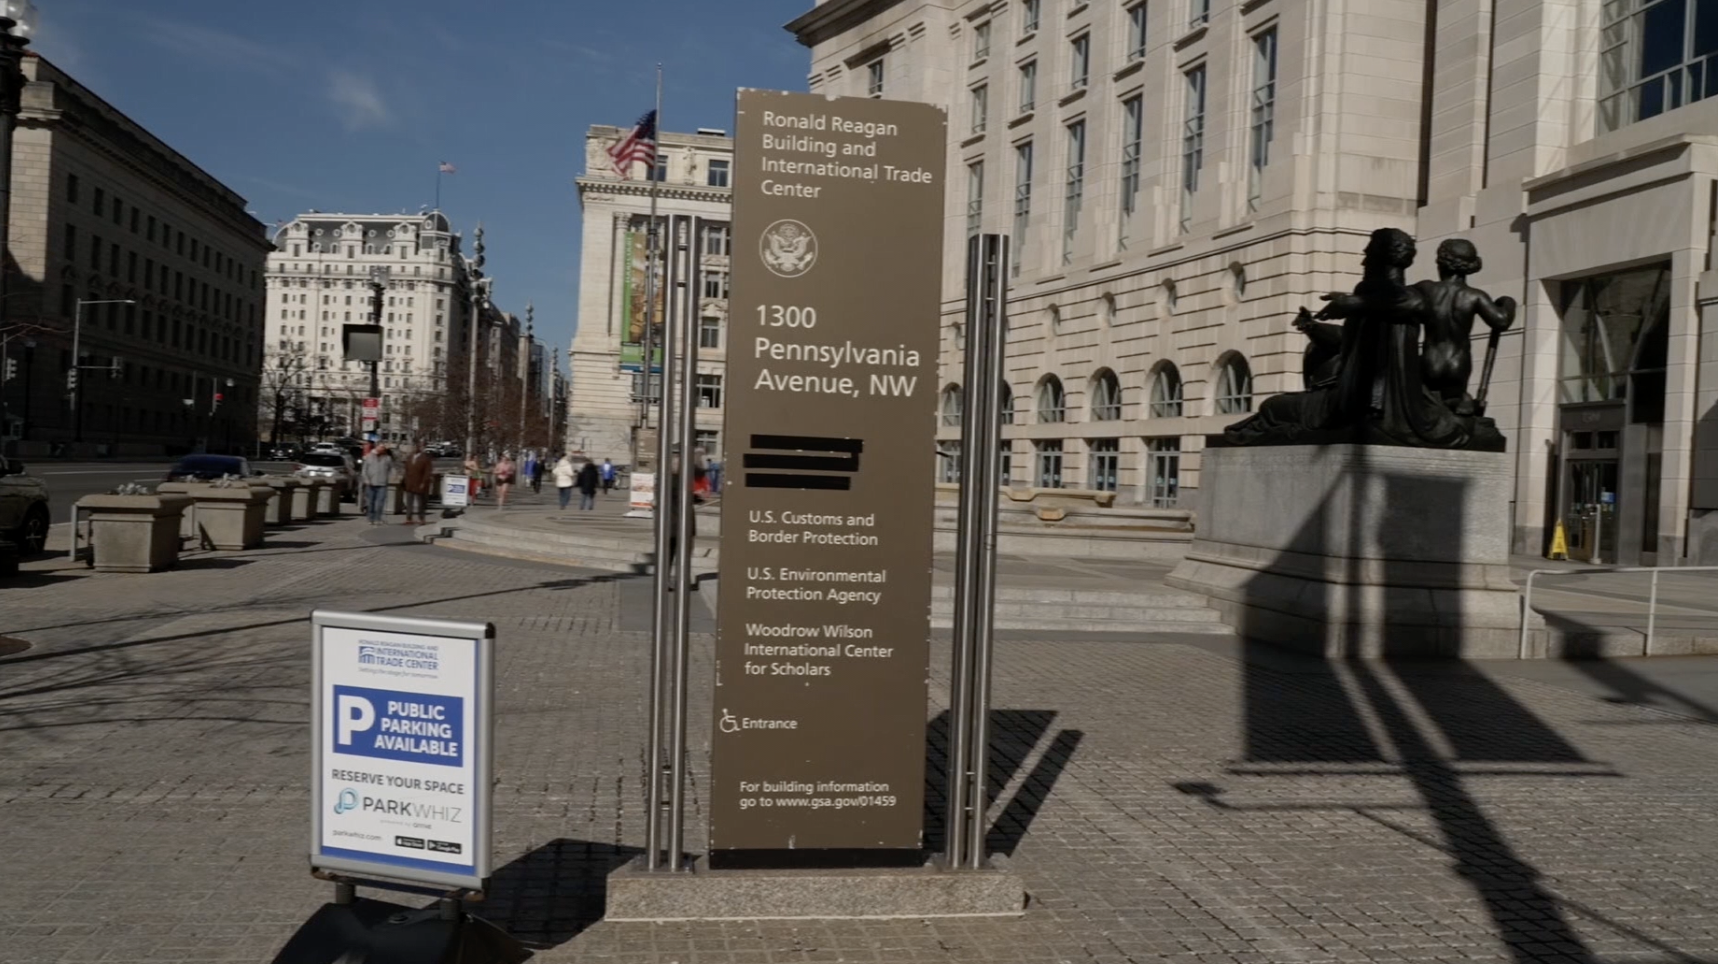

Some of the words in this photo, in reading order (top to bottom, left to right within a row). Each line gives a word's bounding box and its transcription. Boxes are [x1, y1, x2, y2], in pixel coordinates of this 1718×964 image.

[764, 111, 826, 130] Ronald
[832, 117, 898, 138] Reagan
[762, 134, 836, 157] Building
[842, 142, 876, 157] and
[761, 157, 878, 180] International
[884, 166, 932, 184] Trade
[761, 180, 821, 198] Center
[757, 305, 816, 329] 1300
[755, 337, 920, 368] Pennsylvania
[754, 369, 859, 398] Avenue,
[870, 375, 916, 397] NW
[750, 510, 777, 524] U.S.
[781, 511, 843, 526] Customs
[847, 514, 875, 527] and
[749, 530, 798, 543] Border
[803, 531, 878, 546] Protection
[748, 567, 775, 580] U.S.
[780, 568, 886, 583] Environmental
[747, 587, 822, 601] Protection
[827, 589, 881, 604] Agency
[746, 624, 820, 638] Woodrow
[823, 625, 873, 638] Wilson
[375, 647, 438, 660] INTERNATIONAL
[745, 643, 840, 657] International
[845, 645, 894, 658] Center
[375, 656, 403, 667] TRADE
[406, 660, 438, 670] CENTER
[745, 662, 766, 675] for
[771, 663, 831, 676] Scholars
[338, 694, 375, 745] P
[388, 701, 445, 720] PUBLIC
[381, 718, 452, 738] PARKING
[742, 718, 798, 729] Entrance
[374, 735, 458, 756] AVAILABLE
[332, 769, 384, 785] RESERVE
[386, 775, 421, 789] YOUR
[425, 780, 464, 794] SPACE
[740, 781, 760, 792] For
[763, 781, 814, 795] building
[817, 781, 889, 792] information
[362, 796, 462, 823] PARKWHIZ
[739, 798, 755, 809] go
[759, 797, 773, 807] to
[776, 796, 897, 808] www.gsa.gov/01459
